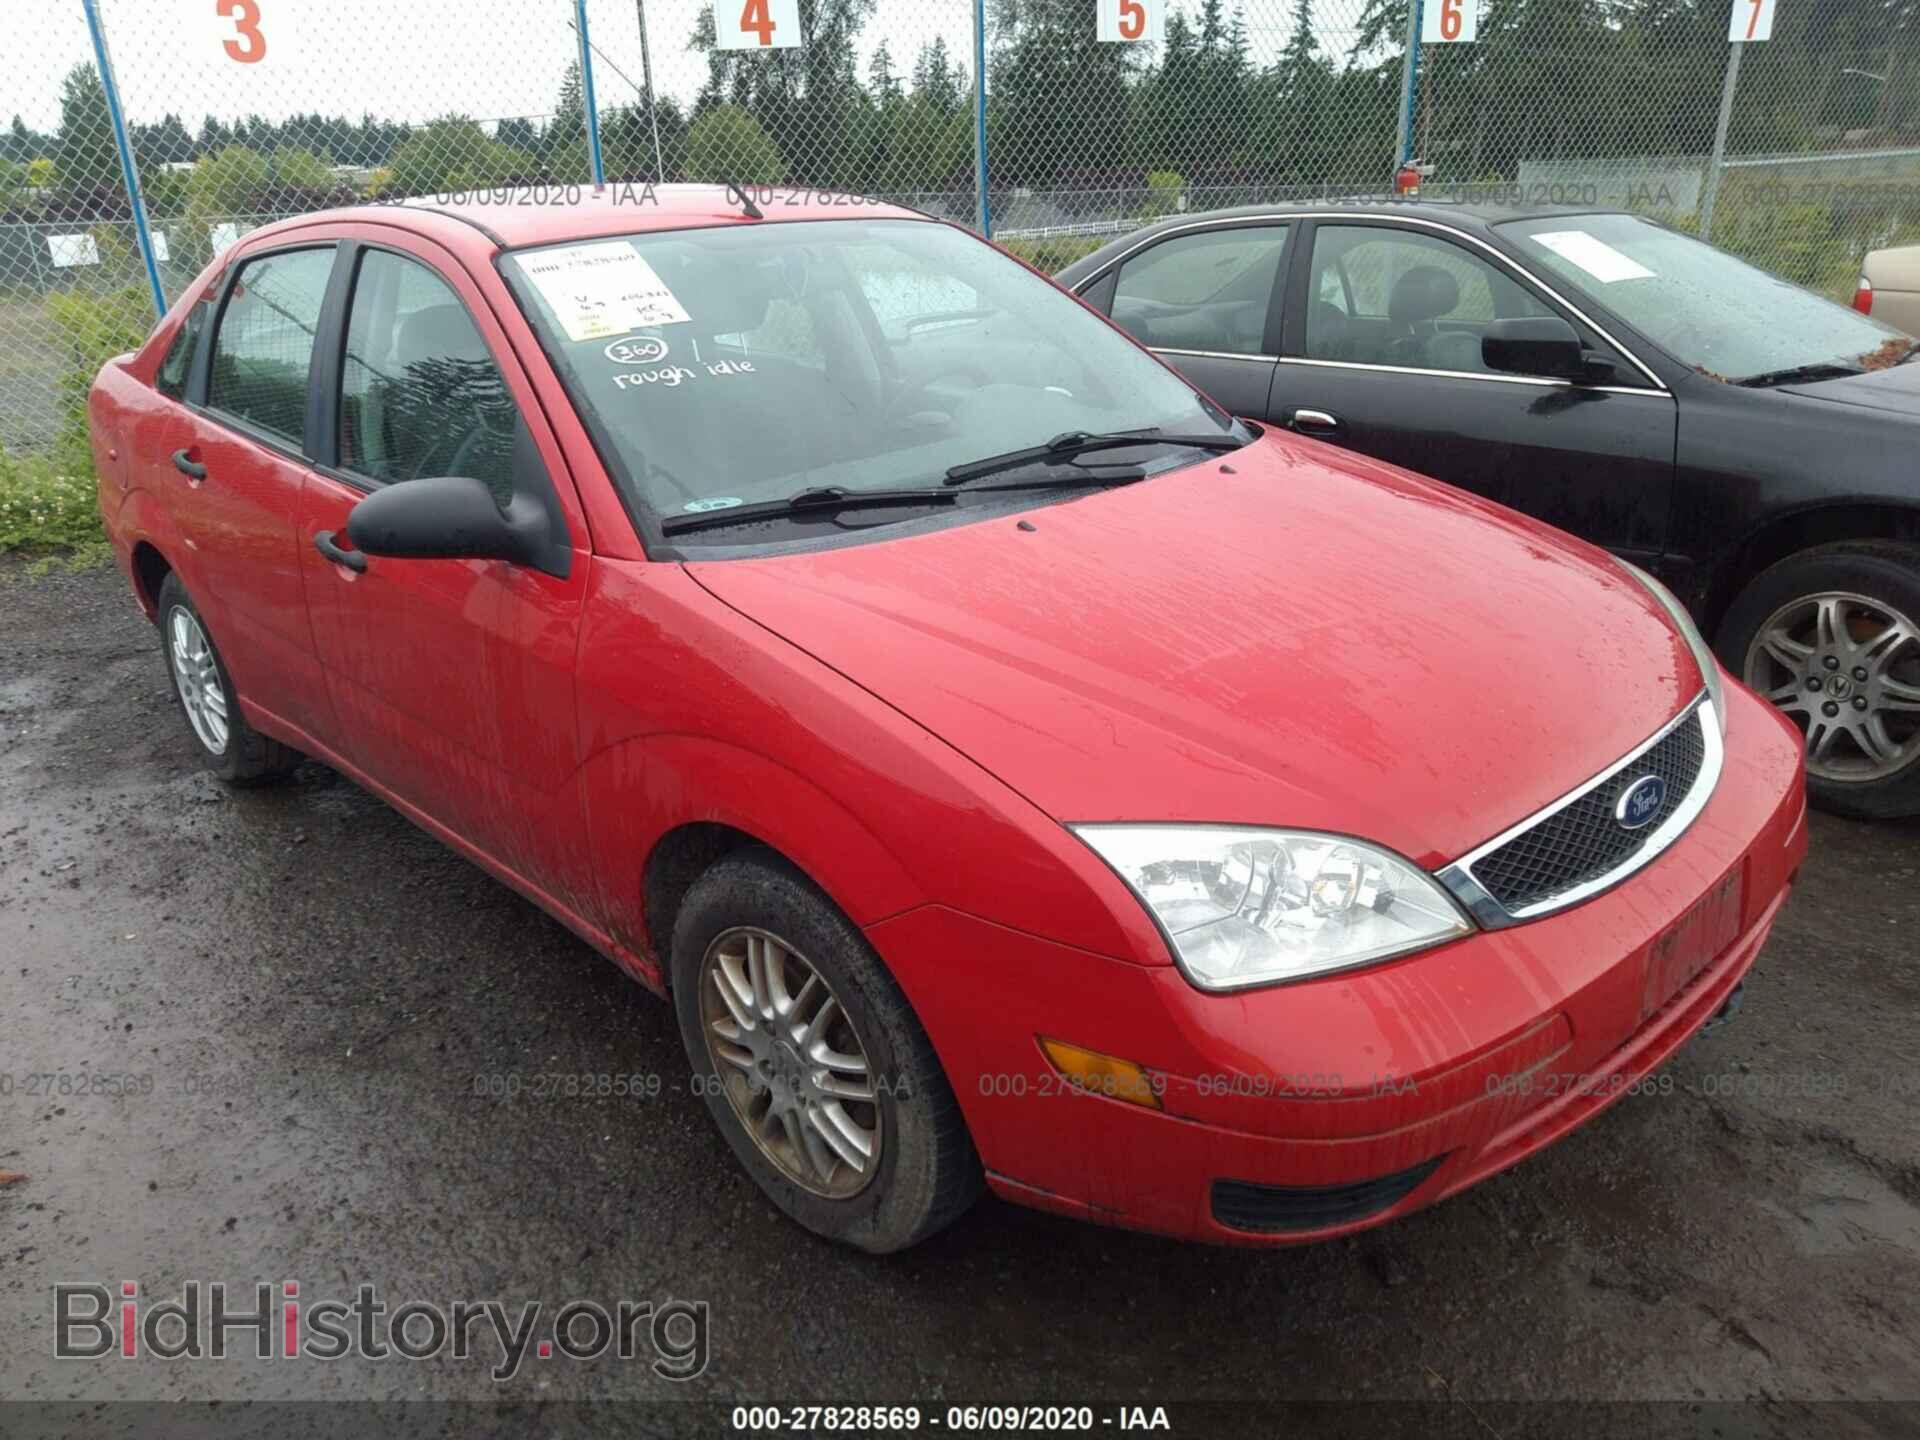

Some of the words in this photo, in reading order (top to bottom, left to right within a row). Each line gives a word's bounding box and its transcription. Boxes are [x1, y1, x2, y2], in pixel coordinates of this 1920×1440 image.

[217, 0, 266, 63] 3
[741, 0, 776, 45] 4
[1119, 0, 1145, 39] 5
[1441, 0, 1462, 40] 6
[1746, 0, 1762, 39] 7
[615, 343, 660, 361] 360
[612, 365, 697, 389] rough
[703, 359, 756, 376] idle
[1632, 786, 1659, 817] Ford
